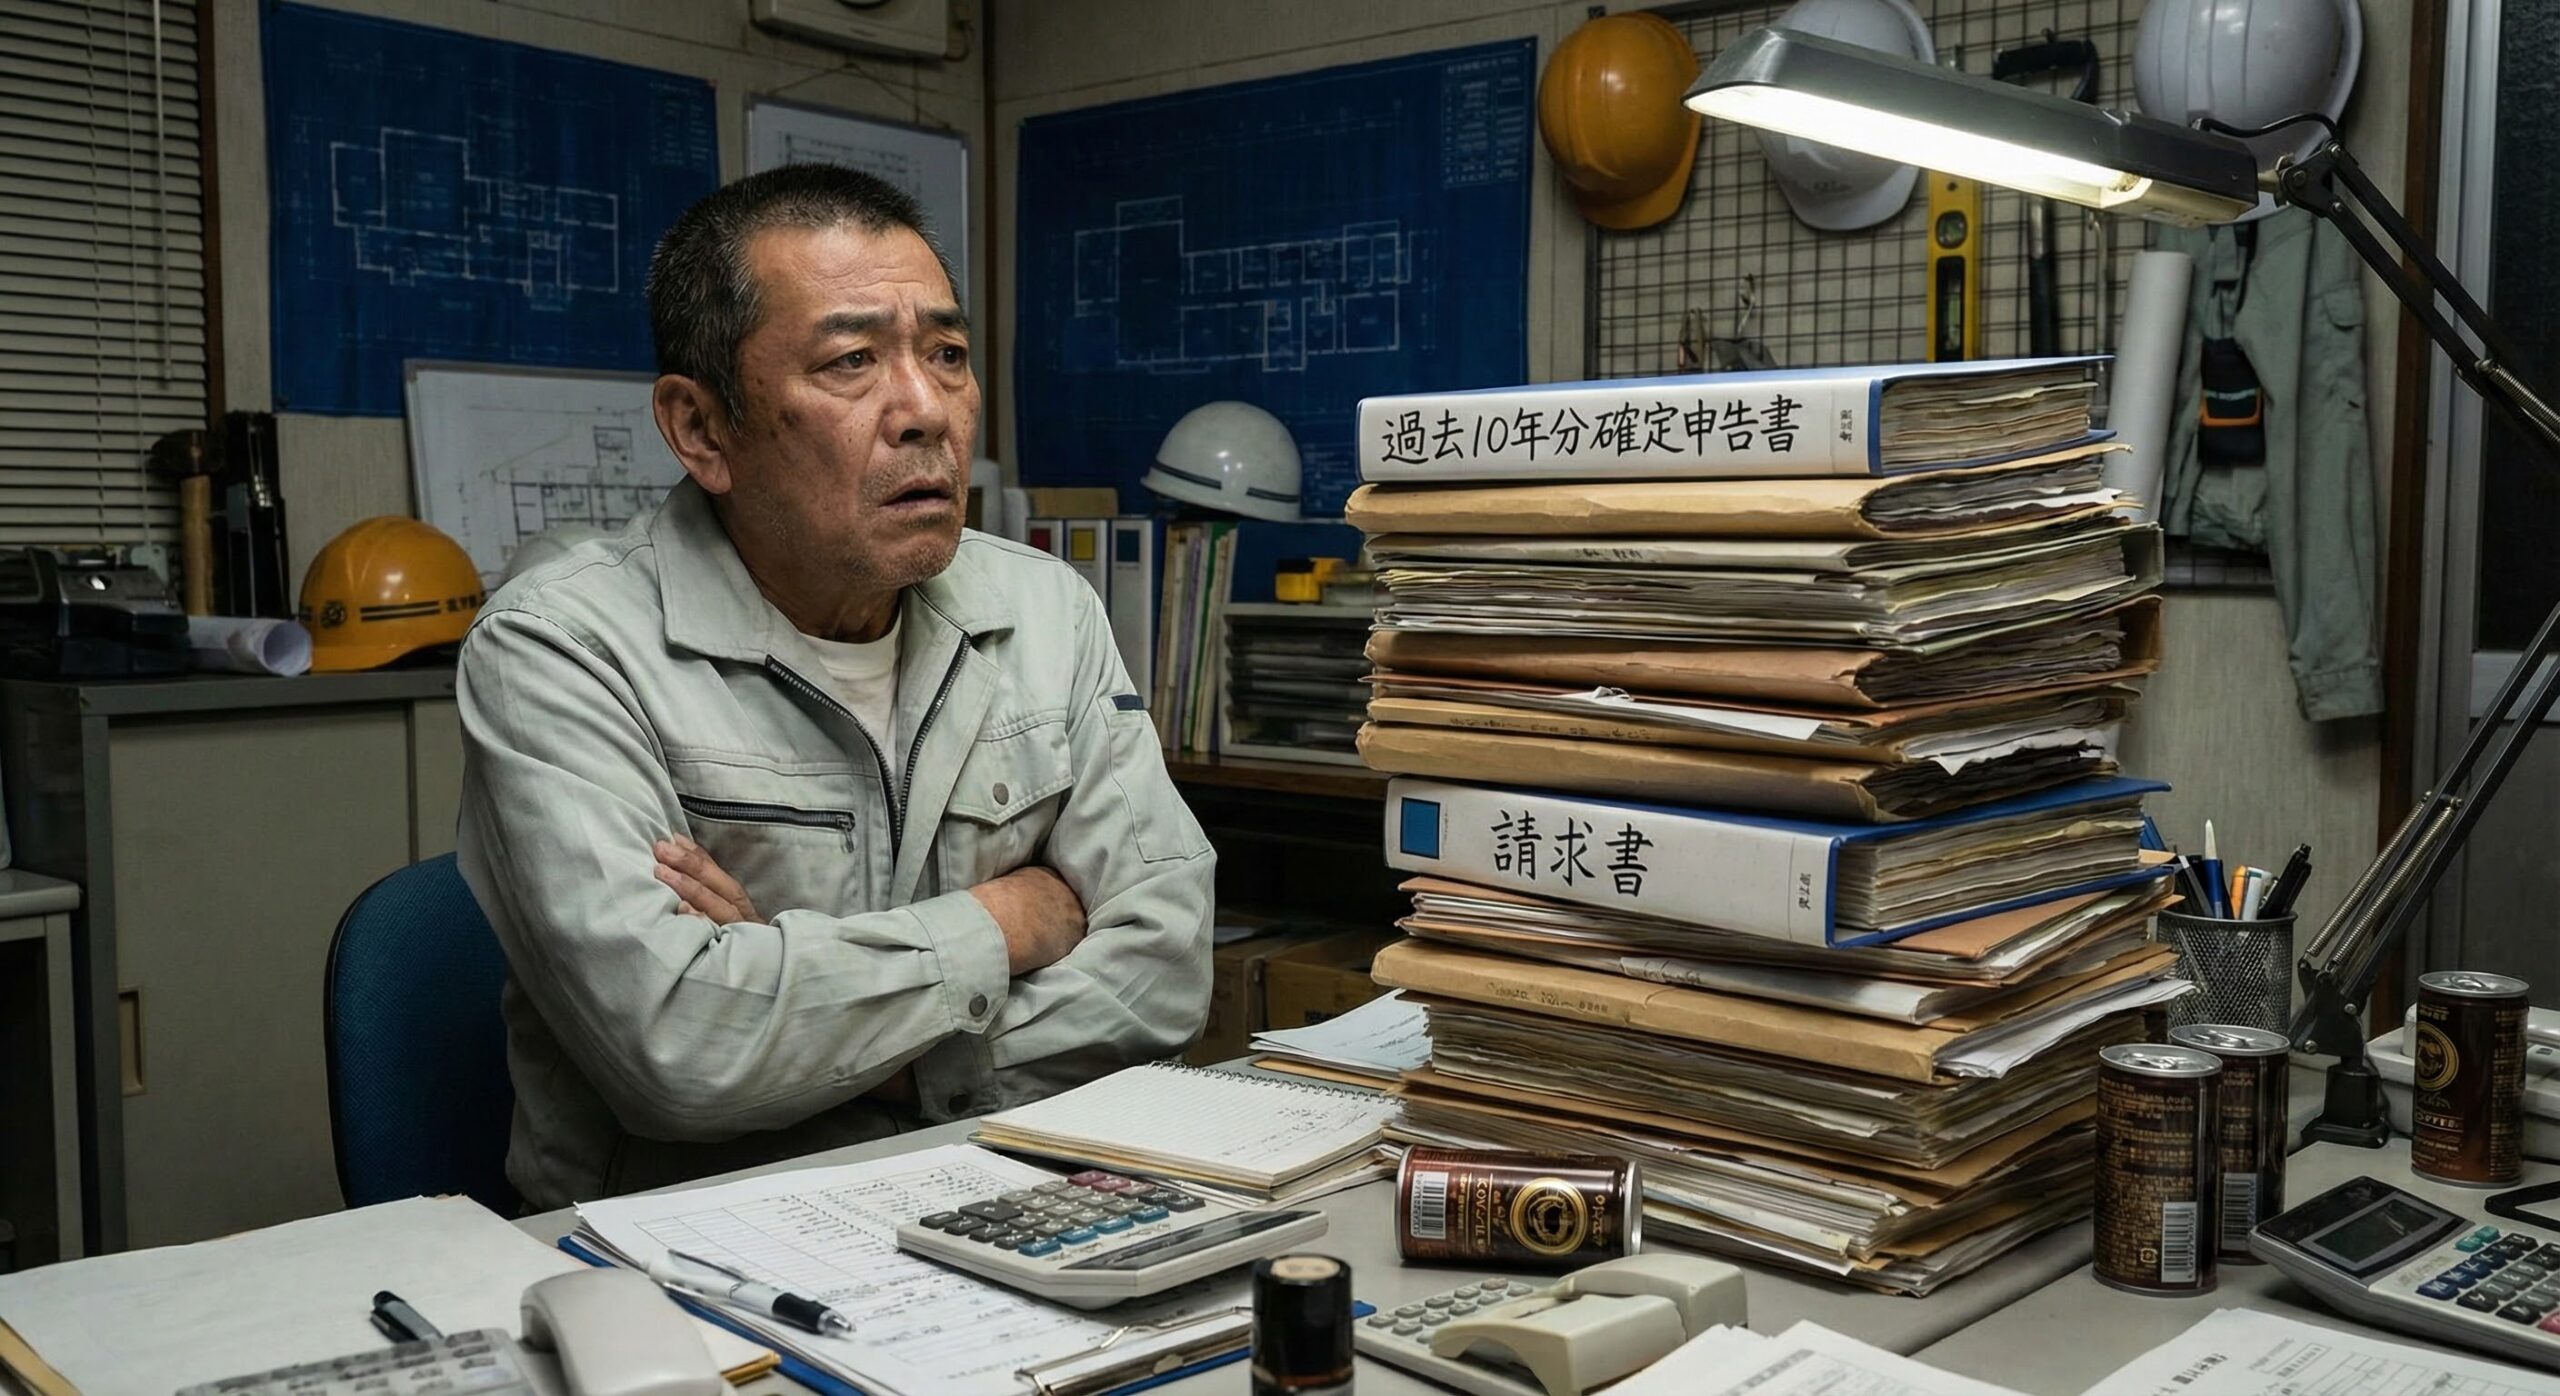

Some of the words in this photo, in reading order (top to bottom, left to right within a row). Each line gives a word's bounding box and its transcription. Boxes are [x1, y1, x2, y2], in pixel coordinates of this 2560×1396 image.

[1381, 394, 1802, 464] 過去10年分確定申告書
[1491, 809, 1654, 897] 請求書
